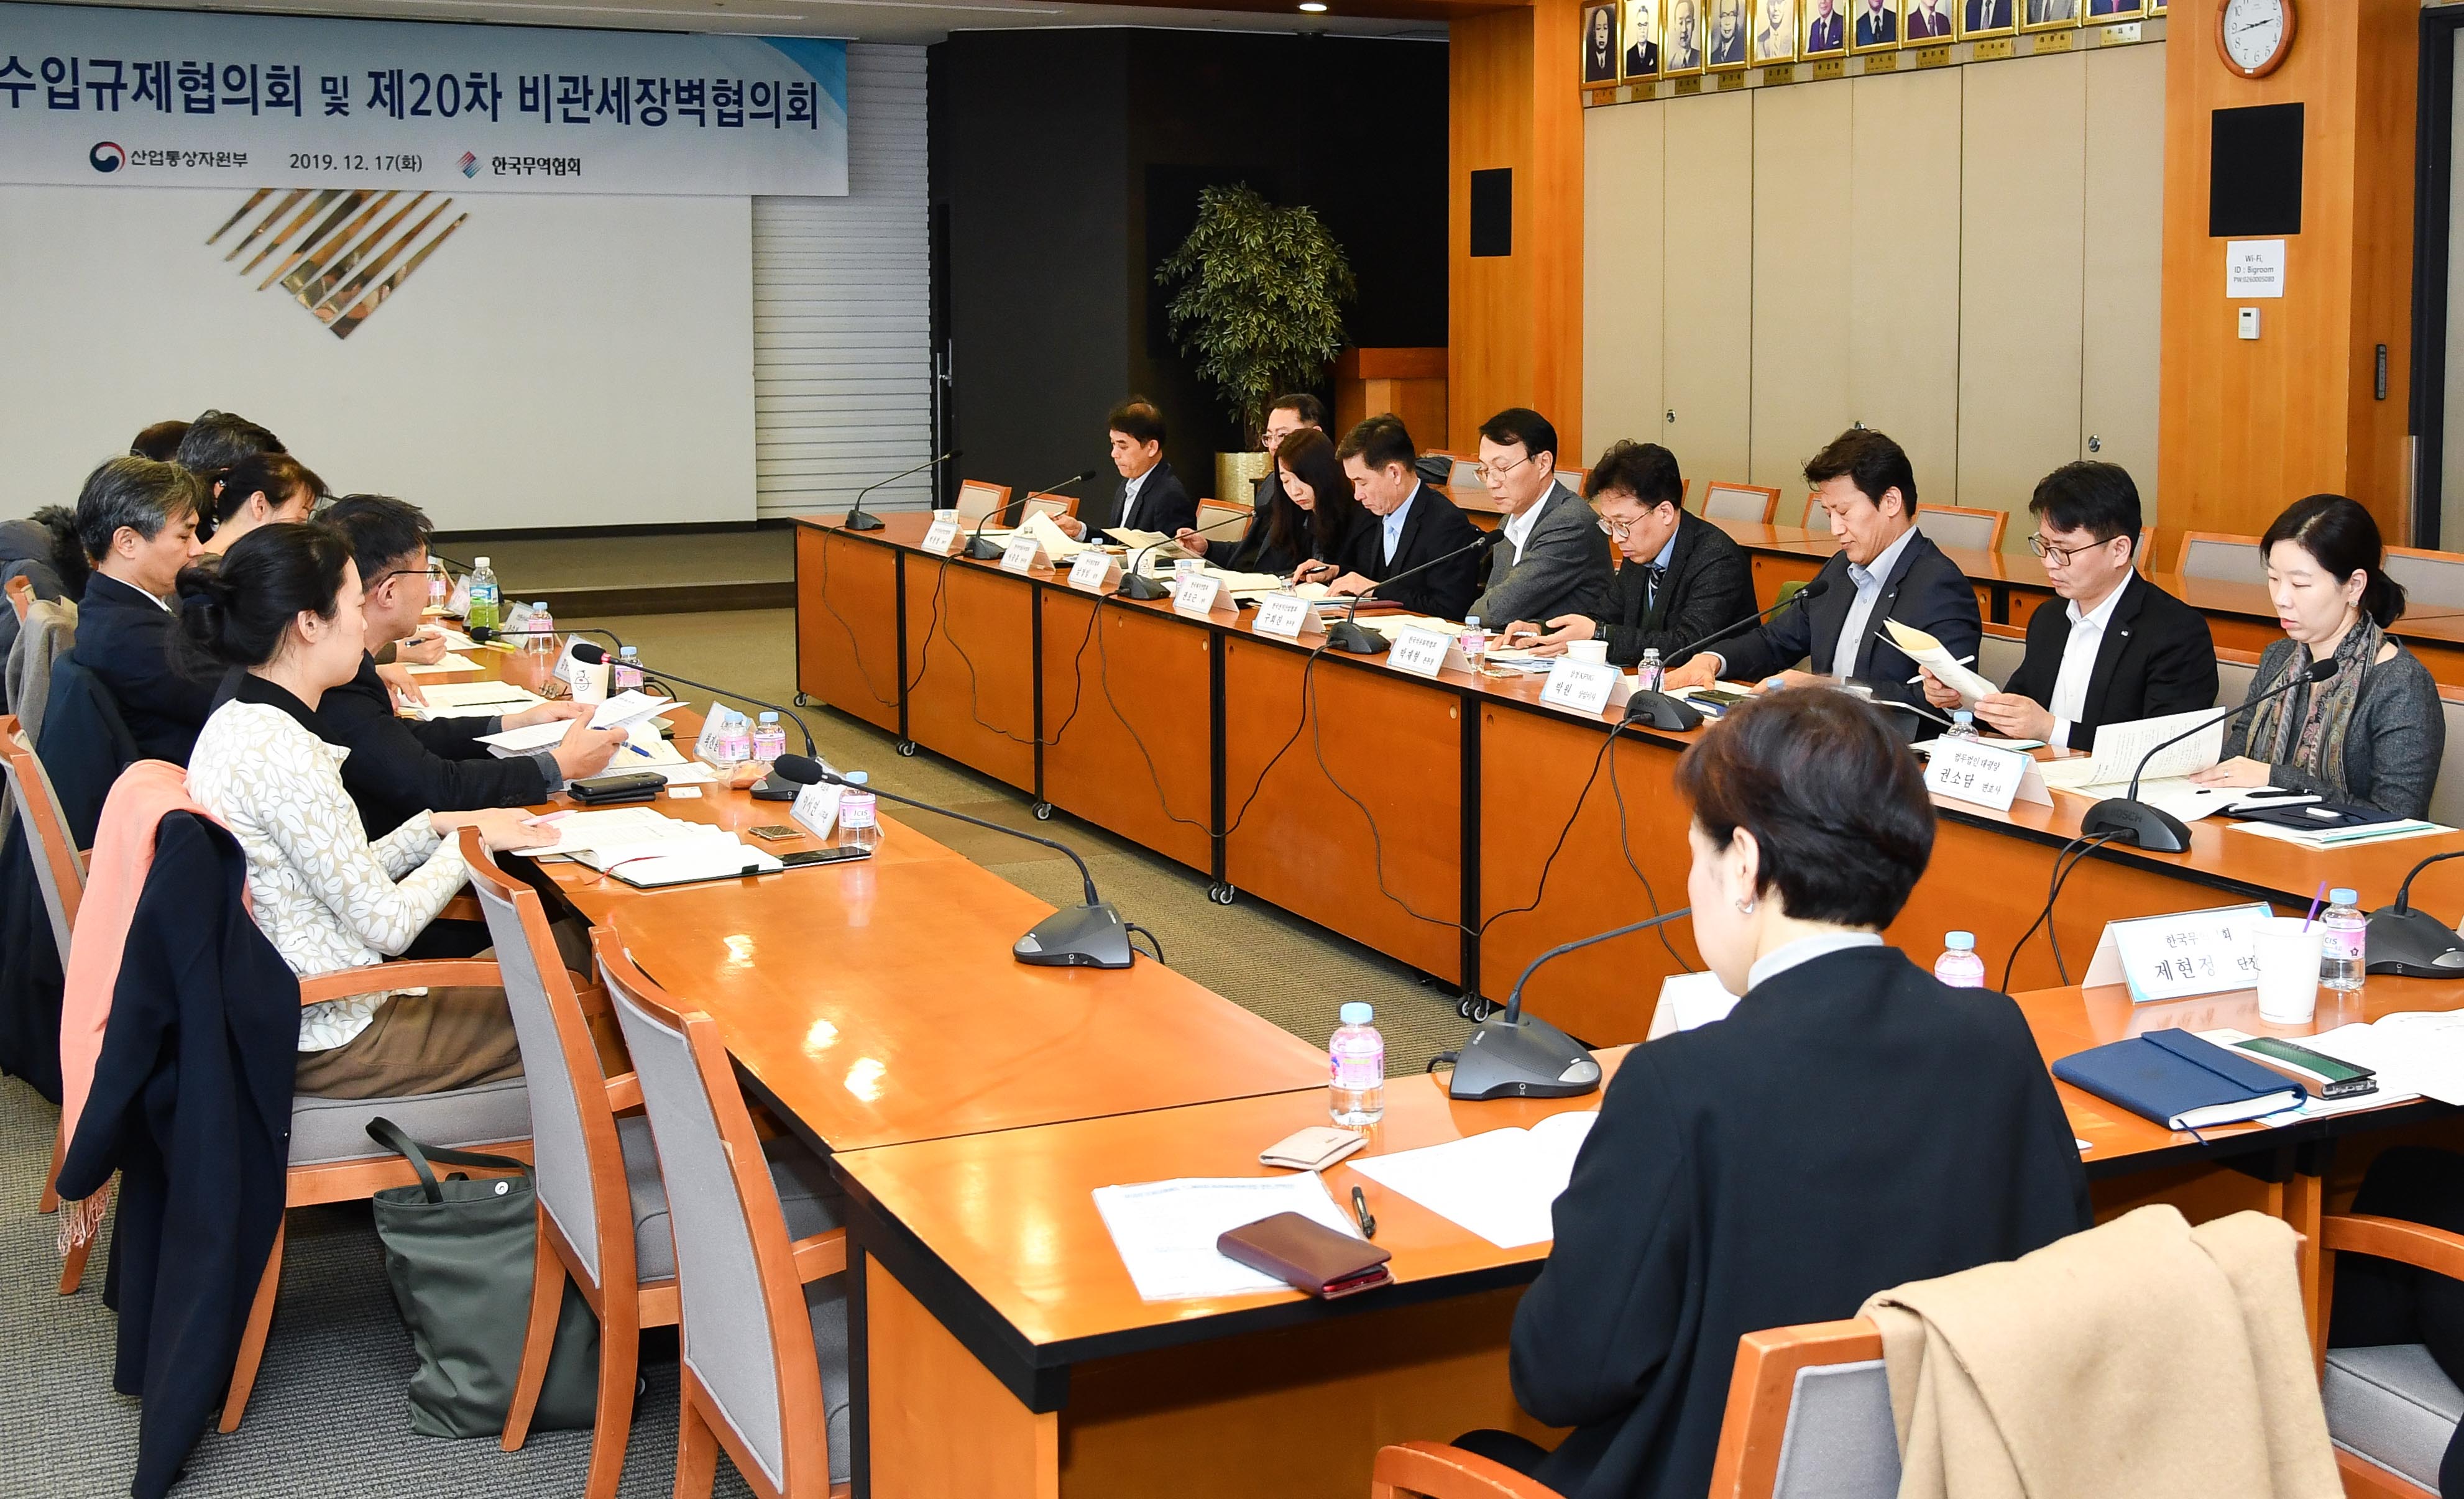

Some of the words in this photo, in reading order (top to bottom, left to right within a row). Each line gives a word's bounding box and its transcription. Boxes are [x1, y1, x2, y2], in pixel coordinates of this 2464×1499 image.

[2235, 5, 2242, 16] 10
[2276, 16, 2282, 27] 3
[2232, 22, 2238, 34] 9
[2235, 37, 2241, 49] 8
[2273, 32, 2278, 44] 4
[2243, 48, 2248, 60] 7
[2254, 50, 2260, 62] 6
[2264, 45, 2271, 57] 5
[0, 55, 302, 117] 수입규제협의회
[321, 75, 349, 117] 및
[367, 68, 503, 122] 제20차
[518, 73, 818, 130] 비관세장벽협의회
[131, 149, 249, 168] 산업통상자원부
[290, 153, 338, 170] 2019.
[344, 154, 369, 171] 12.
[375, 154, 423, 173] 17(화)
[492, 156, 581, 176] 한국무역협회
[2247, 266, 2274, 275] Bigroom
[1954, 753, 1980, 768] 법무법인
[1941, 768, 1975, 789] 권소담
[1982, 782, 2002, 795] 변호사
[2110, 809, 2143, 823] BOSCH
[2324, 937, 2338, 945] CIS
[2154, 955, 2215, 981] 제현정
